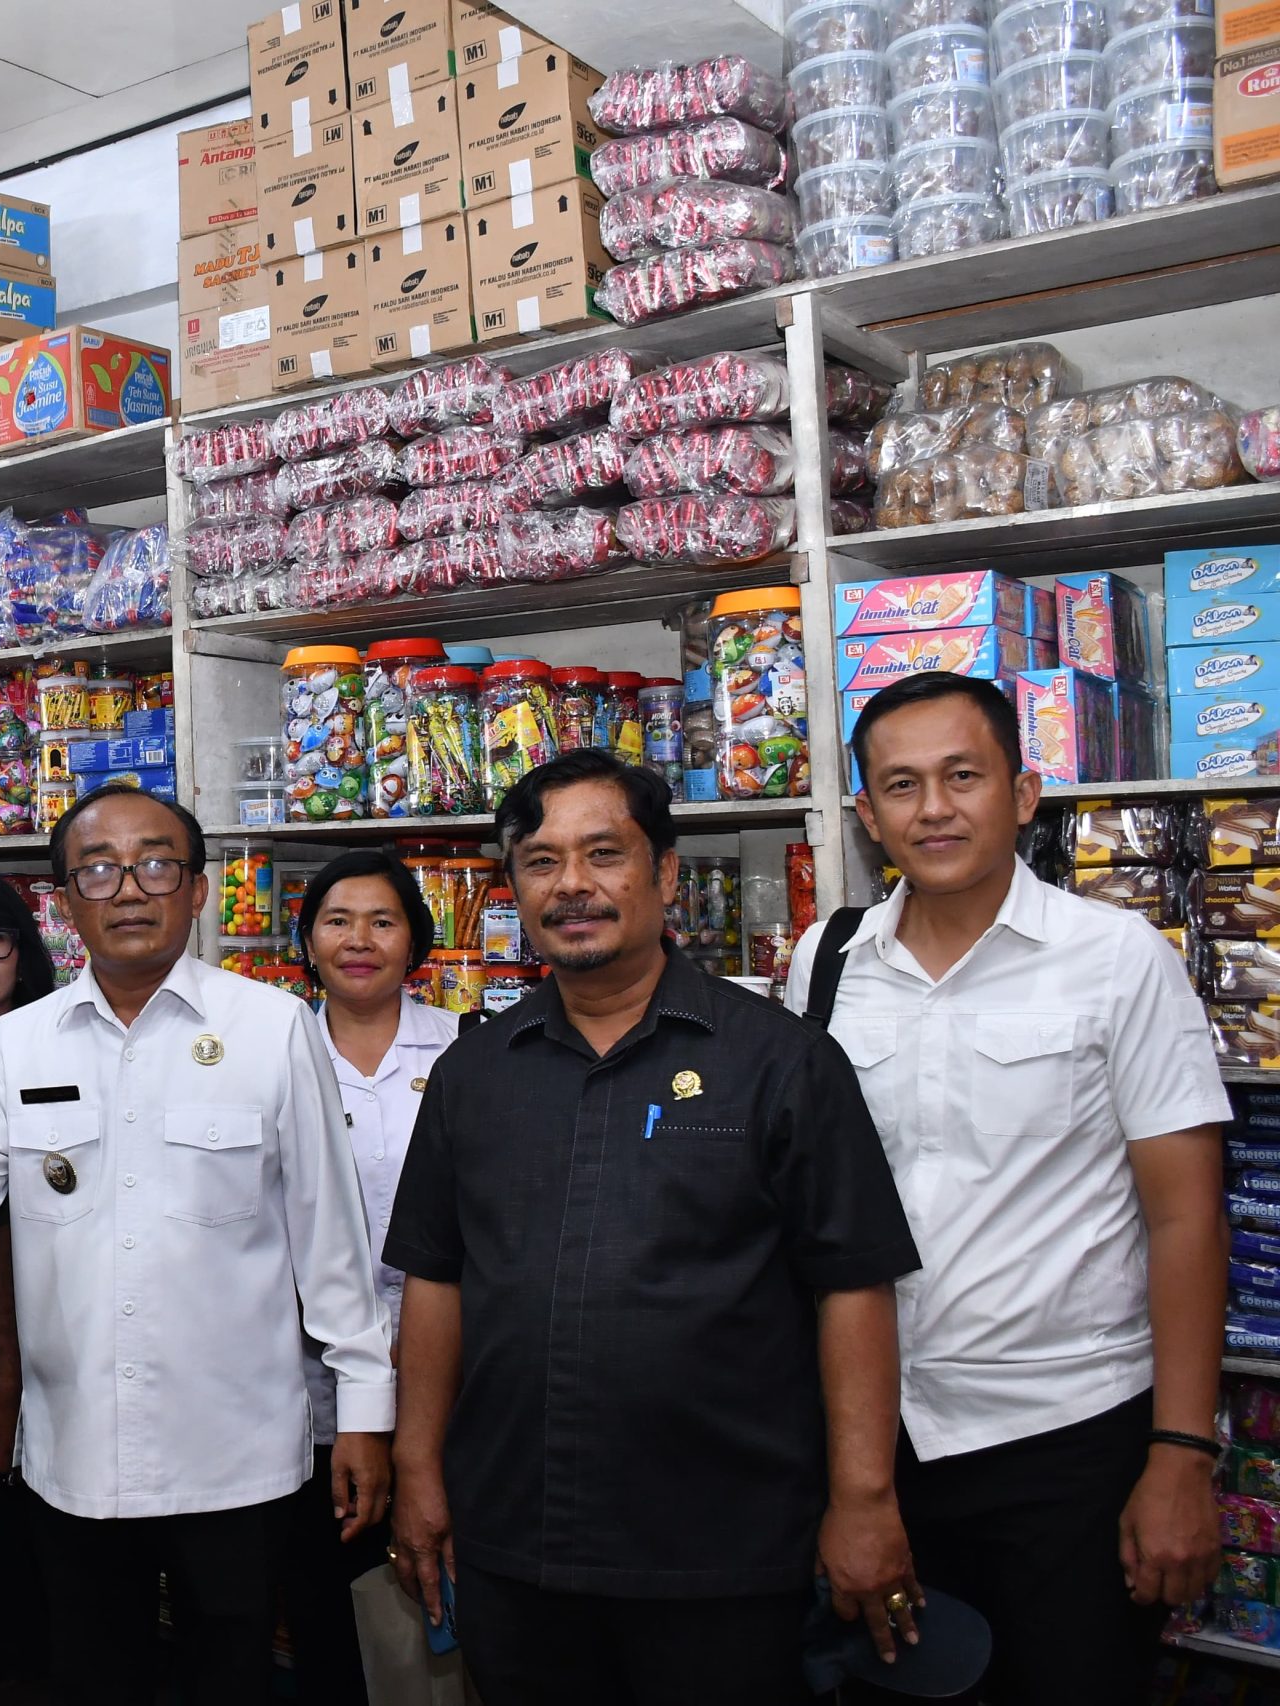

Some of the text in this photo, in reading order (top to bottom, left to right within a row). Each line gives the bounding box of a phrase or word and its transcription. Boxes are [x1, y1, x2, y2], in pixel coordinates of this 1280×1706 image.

[315, 4, 329, 19] M1
[466, 44, 485, 61] M1
[358, 81, 374, 97] M1
[326, 127, 340, 142] M1
[477, 137, 494, 146] KALDU
[496, 132, 508, 140] SARI
[510, 126, 530, 136] NABATI
[531, 115, 561, 129] INDONESIA
[475, 175, 492, 191] M1
[369, 209, 383, 223] M1
[194, 255, 236, 277] MADU
[480, 256, 573, 286] PT KALDU SARI NABATI INDONESIA
[203, 264, 260, 289] SACHET
[485, 312, 502, 328] M1
[379, 337, 394, 351] M1
[281, 358, 295, 372] M1
[128, 386, 141, 398] Teh
[124, 398, 163, 416] Jasmine
[1192, 561, 1239, 580] Dilan
[859, 600, 939, 621] double Oat
[1194, 608, 1241, 627] Dilan
[861, 655, 941, 676] double Oat
[1195, 658, 1243, 677] Dilan
[1198, 706, 1245, 724] Dilan
[1197, 754, 1245, 772] Dilan
[1228, 1333, 1280, 1347] GORIORI
